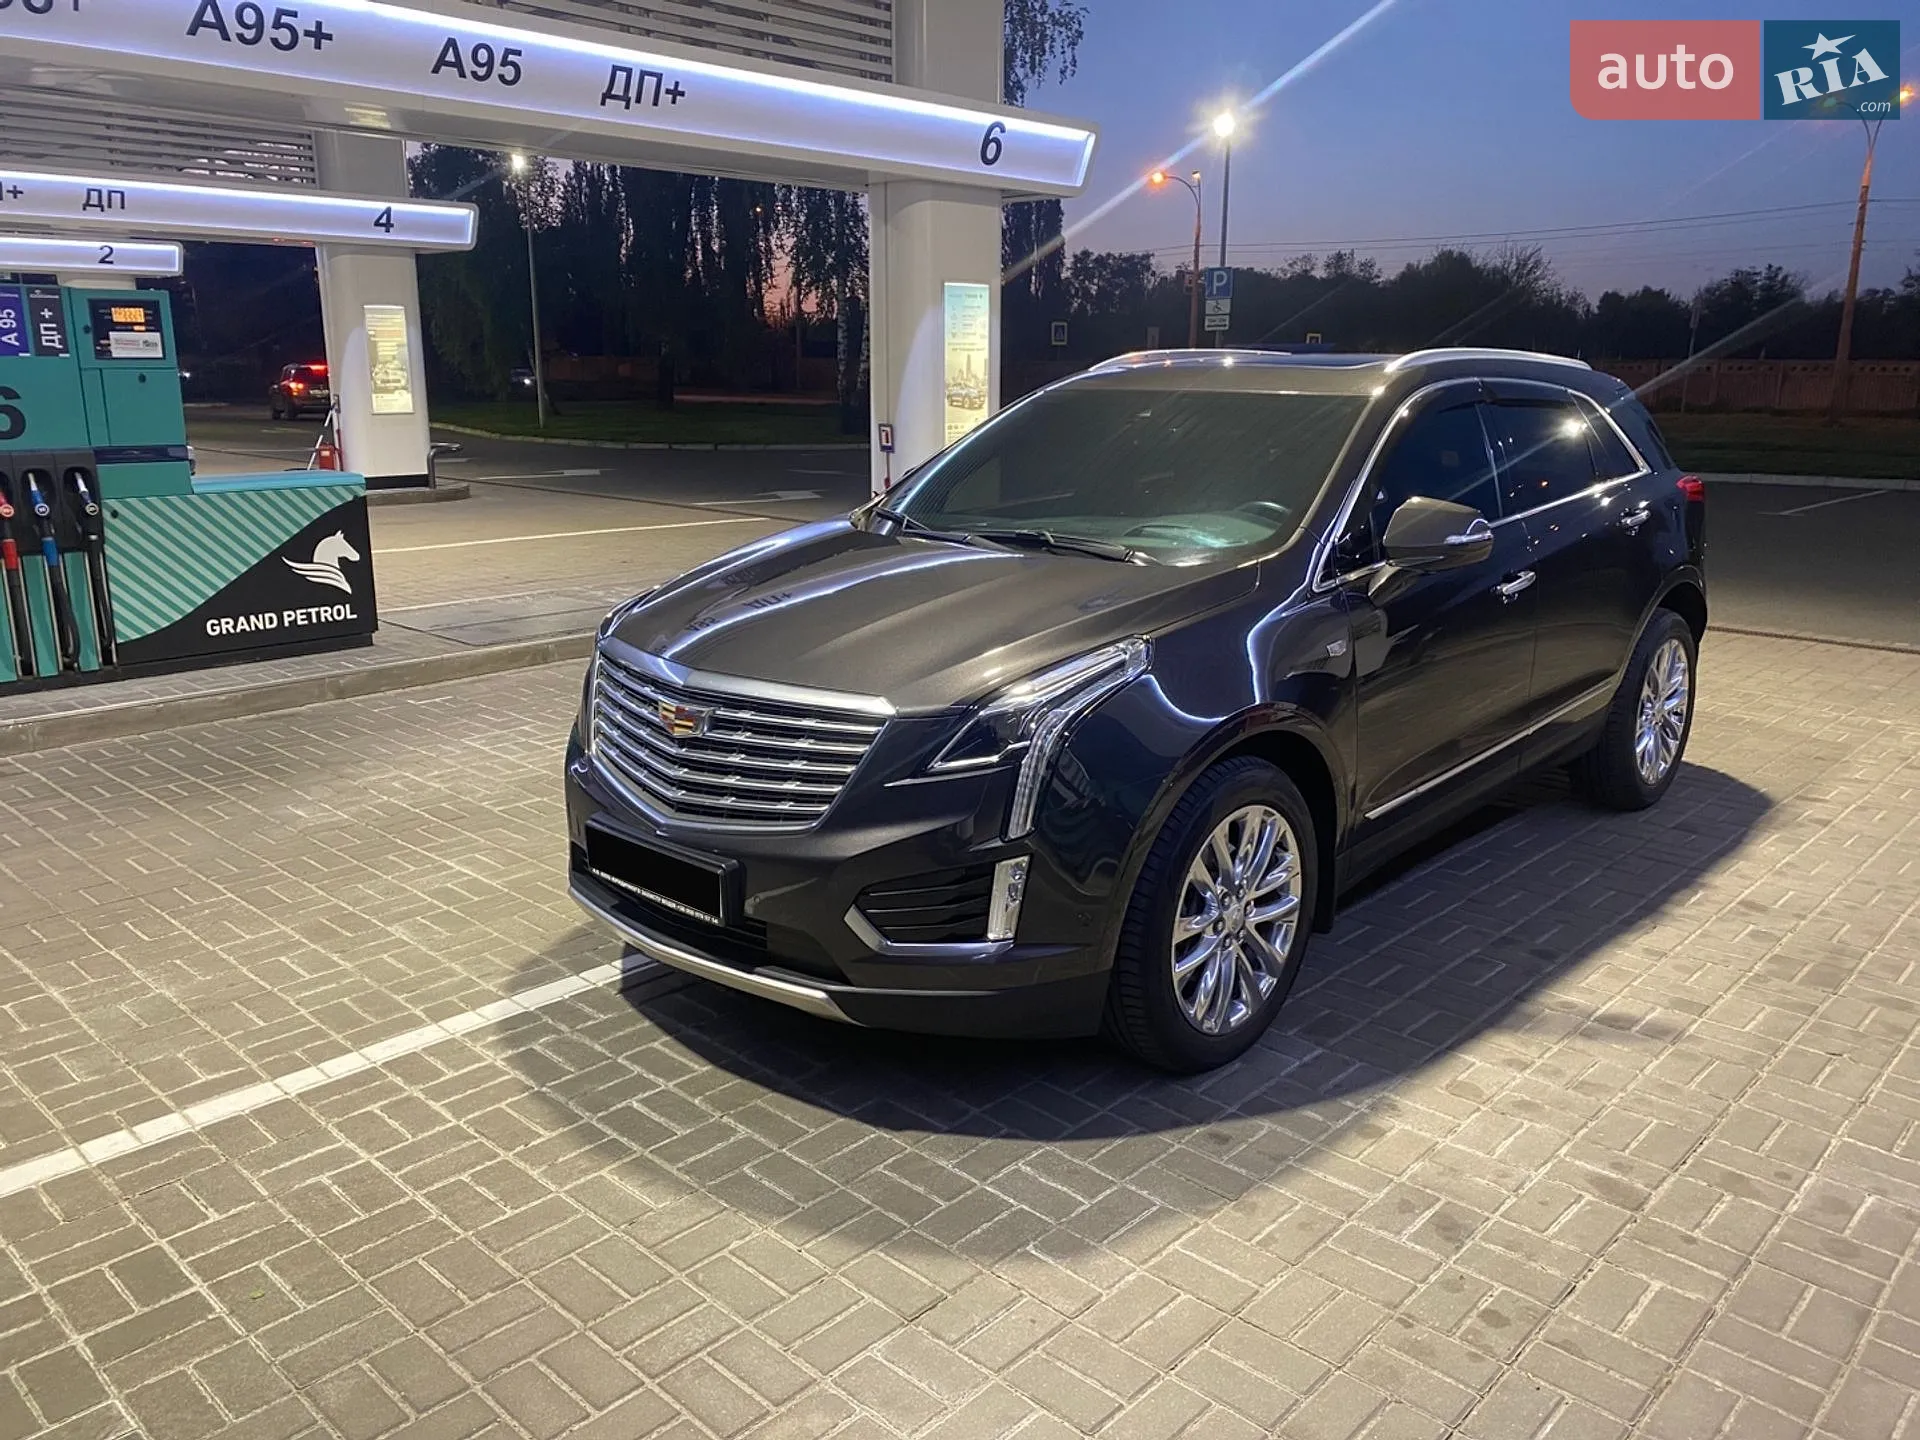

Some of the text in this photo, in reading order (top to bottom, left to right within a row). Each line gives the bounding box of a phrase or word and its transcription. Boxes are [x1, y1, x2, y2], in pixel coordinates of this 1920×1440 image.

[431, 37, 523, 86] А95
[600, 64, 686, 110] ДП+
[980, 121, 1007, 166] 6
[82, 188, 126, 212] ДП
[373, 206, 395, 233] 4
[97, 245, 115, 265] 2
[1213, 270, 1228, 295] P
[206, 603, 358, 636] GRAND PETROL
